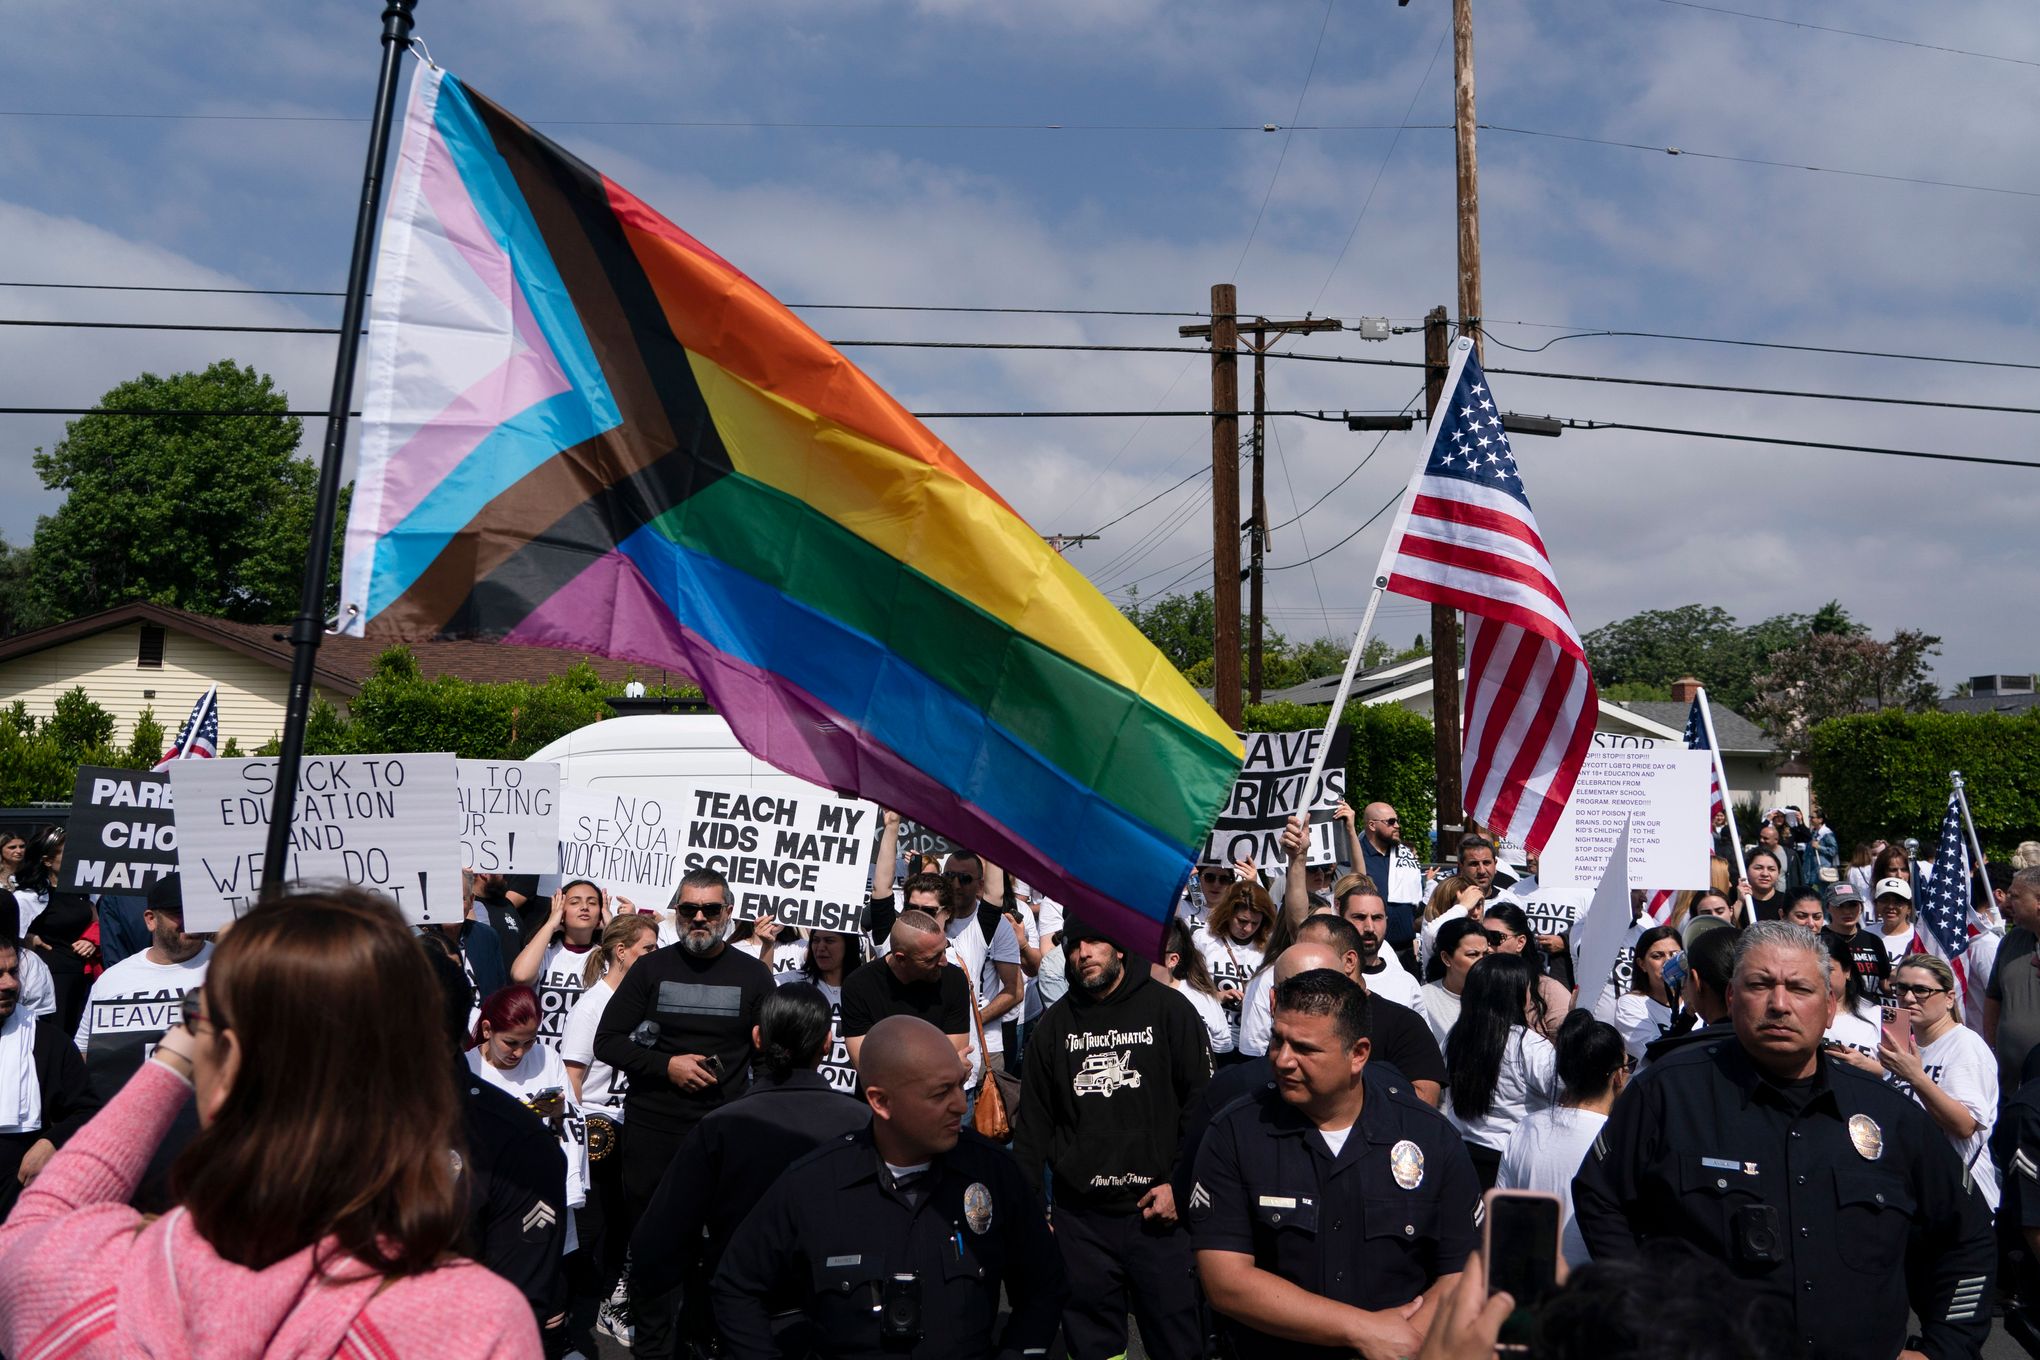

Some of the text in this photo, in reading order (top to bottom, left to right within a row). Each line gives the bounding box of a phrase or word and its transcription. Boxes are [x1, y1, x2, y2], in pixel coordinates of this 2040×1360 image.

[1236, 730, 1325, 769] AVE
[362, 760, 404, 787] TO
[487, 766, 523, 788] TO
[614, 796, 662, 826] NO
[694, 789, 798, 827] TEACH
[817, 804, 865, 836] MY
[687, 820, 760, 853] KIDS
[774, 830, 861, 866] MATH
[343, 847, 390, 887] DO
[684, 852, 820, 892] SCIENCE
[738, 892, 862, 932] ENGLISH
